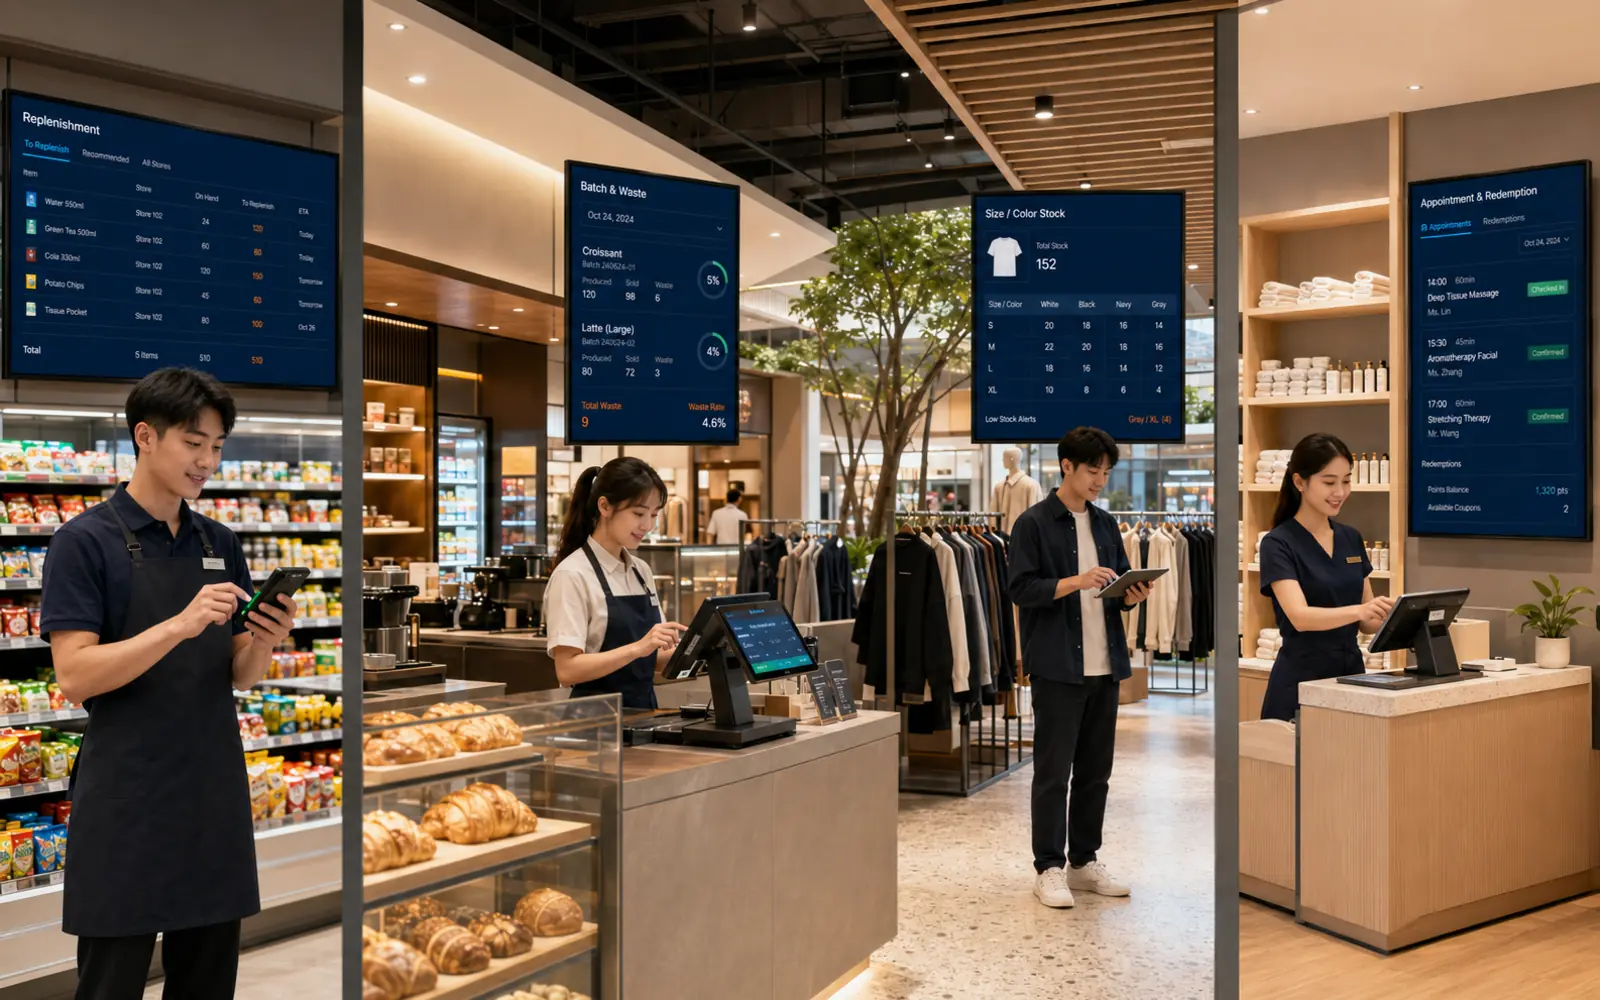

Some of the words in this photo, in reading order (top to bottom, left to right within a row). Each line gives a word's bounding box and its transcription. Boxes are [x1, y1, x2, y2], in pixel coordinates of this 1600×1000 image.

[23, 112, 100, 135] Replenishment
[25, 139, 34, 148] To
[82, 149, 129, 163] Recommended
[152, 160, 171, 170] Stores
[136, 184, 151, 192] Store
[581, 181, 607, 193] Batch
[610, 185, 616, 194] &
[619, 186, 646, 198] Waste
[1421, 194, 1474, 208] Appointment
[1477, 192, 1483, 201] &
[1486, 187, 1537, 200] Redemption
[45, 198, 63, 206] Water
[65, 200, 84, 209] 550ml
[588, 211, 601, 221] Oct
[603, 213, 614, 222] 24,
[616, 214, 634, 223] 2024
[986, 209, 1004, 218] Size
[1013, 209, 1037, 218] Color
[1040, 209, 1065, 218] Stock
[1483, 215, 1525, 224] Redemptions
[45, 225, 64, 233] Green
[1429, 221, 1472, 233] Appointments
[136, 235, 151, 243] Store
[45, 252, 59, 260] Cola
[583, 246, 622, 258] Croissant
[136, 261, 151, 269] Store
[1036, 258, 1056, 269] 152
[45, 279, 65, 287] Potato
[67, 281, 84, 289] Chips
[707, 275, 720, 285] 5%
[1428, 277, 1447, 286] 14:00
[583, 290, 596, 298] 120
[626, 292, 635, 300] 98
[655, 294, 660, 302] 6
[1428, 294, 1445, 302] Deep
[1447, 292, 1468, 300] Tissue
[1116, 301, 1131, 309] Navy
[45, 306, 65, 314] Tissue
[135, 312, 151, 320] Store
[582, 323, 603, 334] Latte
[606, 324, 634, 335] (Large)
[1428, 339, 1447, 347] 15:30
[23, 346, 41, 354] Total
[707, 347, 719, 356] 4%
[582, 354, 611, 362] Produced
[1478, 351, 1497, 359] Facial
[252, 356, 263, 364] 510
[582, 367, 592, 375] 80
[626, 368, 635, 376] 72
[1046, 364, 1053, 372] 18
[1156, 364, 1163, 372] 12
[655, 369, 660, 377] 3
[1441, 368, 1462, 377] Zhang
[988, 386, 997, 394] XL
[1084, 386, 1089, 394] 8
[1121, 386, 1126, 394] 6
[582, 401, 601, 410] Total
[600, 402, 622, 410] Waste
[1428, 400, 1447, 408] 17:00
[582, 416, 588, 427] 9
[702, 418, 726, 427] 4.6%
[1428, 415, 1462, 424] Stretching
[1464, 414, 1490, 423] Therapy
[1440, 430, 1459, 438] Wang
[1422, 460, 1461, 468] Redemptions
[1536, 486, 1555, 495] 1,320
[1557, 487, 1568, 495] pts
[1564, 505, 1568, 513] 2
